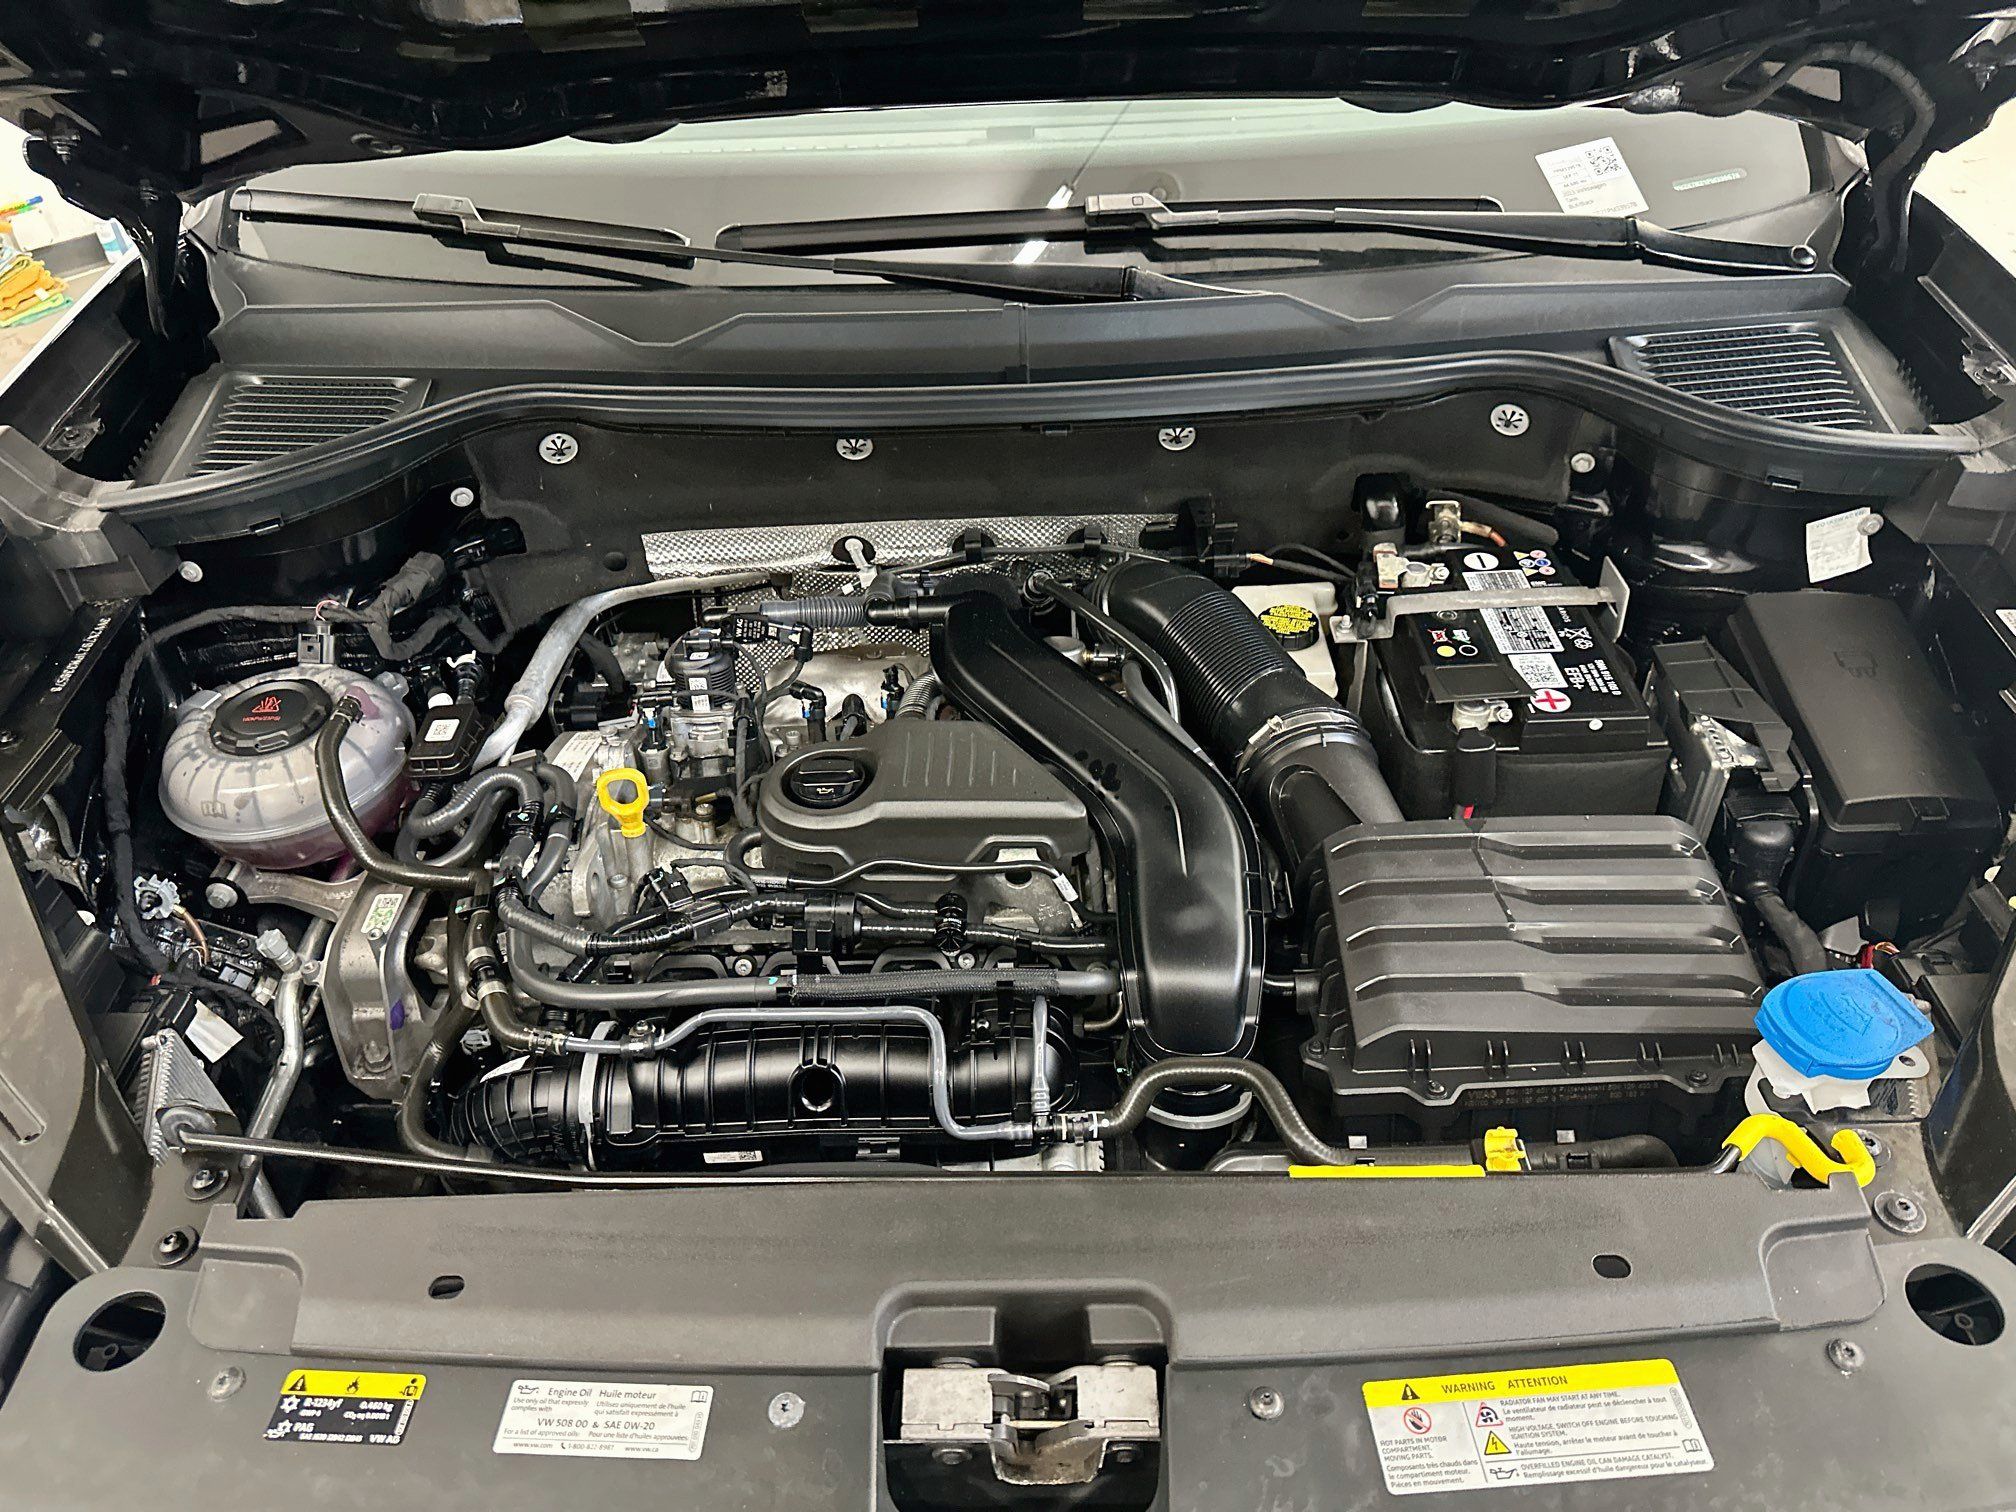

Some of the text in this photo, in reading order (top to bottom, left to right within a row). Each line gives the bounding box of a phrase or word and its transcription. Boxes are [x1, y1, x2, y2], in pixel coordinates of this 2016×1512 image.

[1564, 667, 1586, 690] EFB+
[1441, 1375, 1568, 1394] WARNING ATTENTION
[548, 1387, 593, 1399] Engine Oil
[599, 1389, 657, 1399] Huile moteur
[525, 1397, 538, 1405] only
[561, 1399, 589, 1407] expressly
[1500, 1398, 1531, 1406] RADIATOR
[1560, 1394, 1580, 1402] START
[620, 1402, 658, 1410] uniquement
[1512, 1405, 1546, 1414] ventilateur
[1557, 1402, 1586, 1410] radiateur
[1587, 1401, 1602, 1410] peut
[1612, 1398, 1646, 1407] déclencher
[630, 1410, 674, 1418] expressément
[537, 1418, 656, 1430] VW 508 00 & SAE 0W-20
[1556, 1421, 1580, 1429] SWITCH
[1581, 1419, 1593, 1427] OFF
[1594, 1418, 1619, 1426] ENGINE
[1620, 1416, 1644, 1424] BEFORE
[1646, 1413, 1678, 1422] TOUCHING
[293, 1422, 315, 1432] PAG
[368, 1434, 385, 1443] VW
[386, 1435, 400, 1444] AG
[1424, 1435, 1447, 1443] MOTOR
[1510, 1432, 1540, 1440] IGNITION
[1514, 1441, 1534, 1449] Haute
[1593, 1435, 1617, 1443] moteur
[1647, 1430, 1672, 1438] toucher
[1384, 1454, 1410, 1462] MOVING
[1521, 1461, 1560, 1470] OVERFILLED
[1561, 1459, 1586, 1467] ENGINE
[1613, 1454, 1640, 1462] DAMAGE
[1386, 1463, 1426, 1472] Composants
[1439, 1460, 1462, 1468] chauds
[1523, 1470, 1564, 1479] Remplissage
[1565, 1467, 1591, 1475] excessif
[1615, 1463, 1649, 1472] dangereux
[1650, 1462, 1664, 1470] pour
[1396, 1470, 1443, 1480] compartiment
[1390, 1480, 1412, 1488] Pièces
